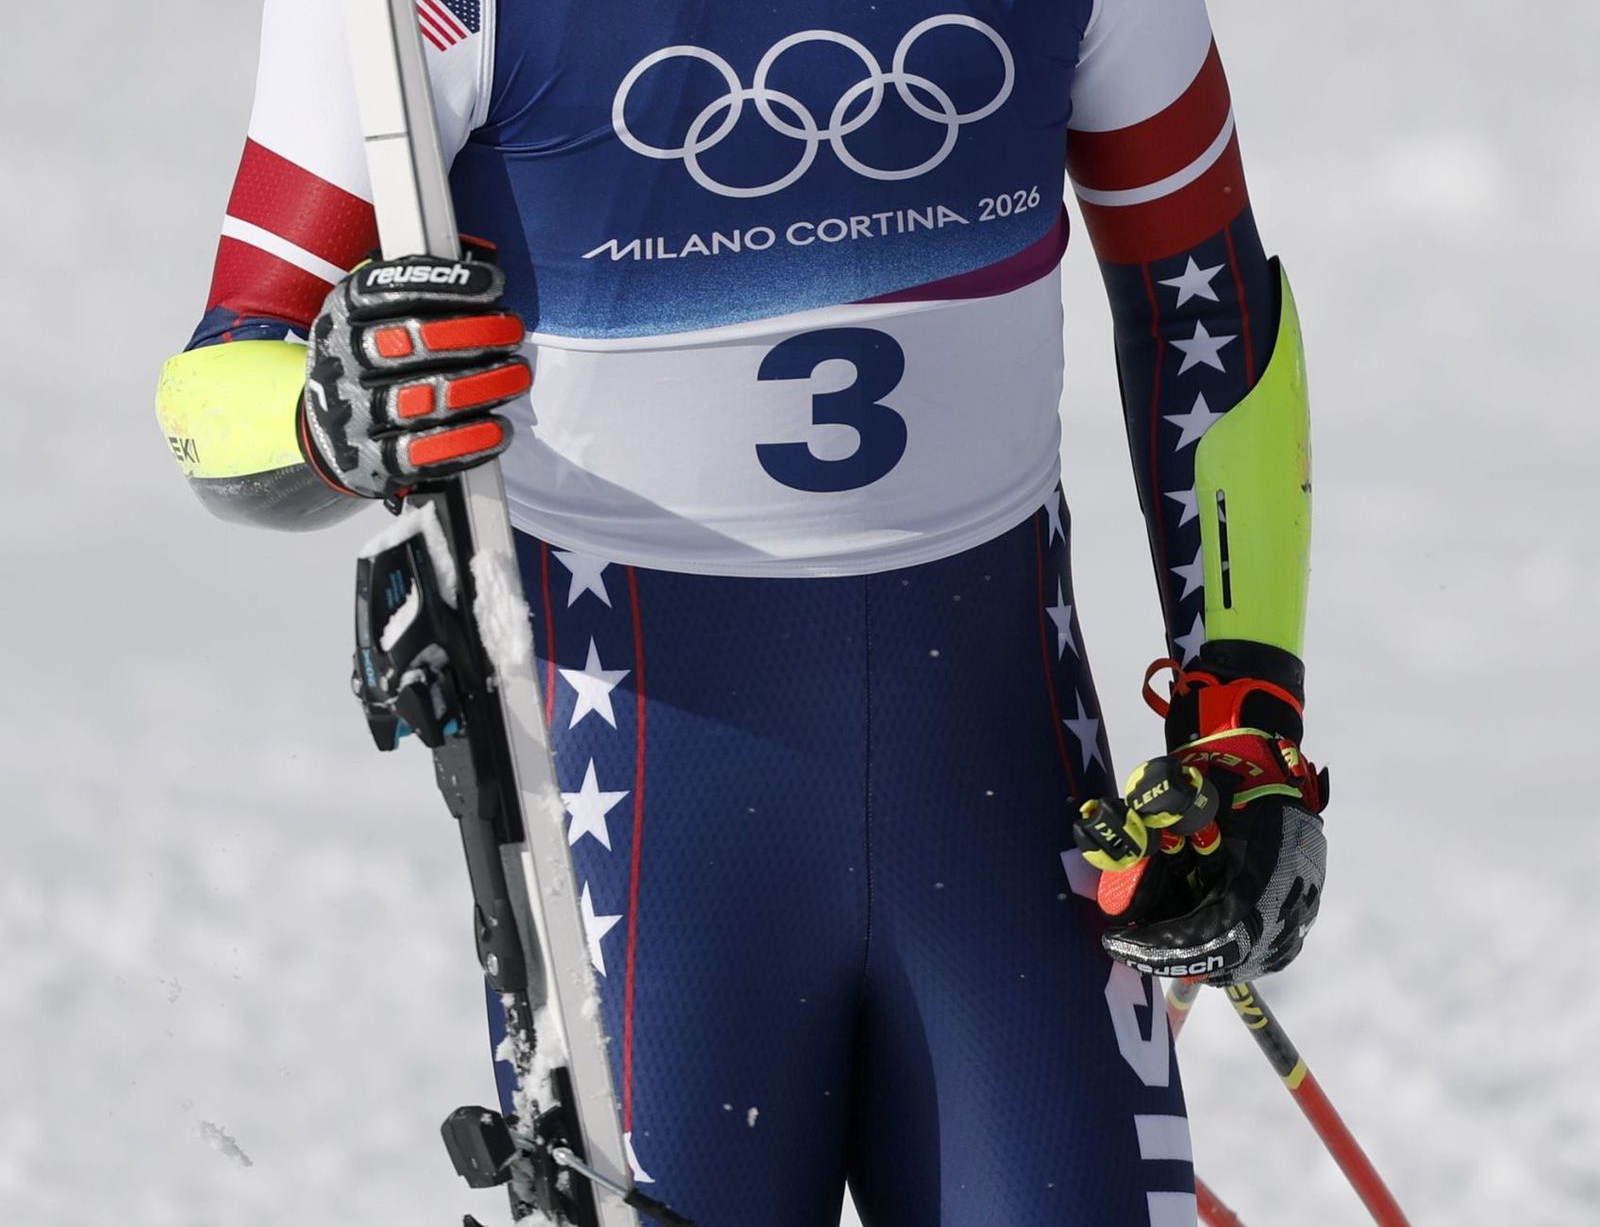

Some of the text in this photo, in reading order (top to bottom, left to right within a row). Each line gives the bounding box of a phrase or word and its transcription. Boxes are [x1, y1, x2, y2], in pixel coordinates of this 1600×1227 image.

[581, 186, 1041, 261] MILANO CORTINA 2026
[366, 263, 470, 286] reusch
[755, 327, 908, 492] 3
[1133, 779, 1169, 810] LEKI
